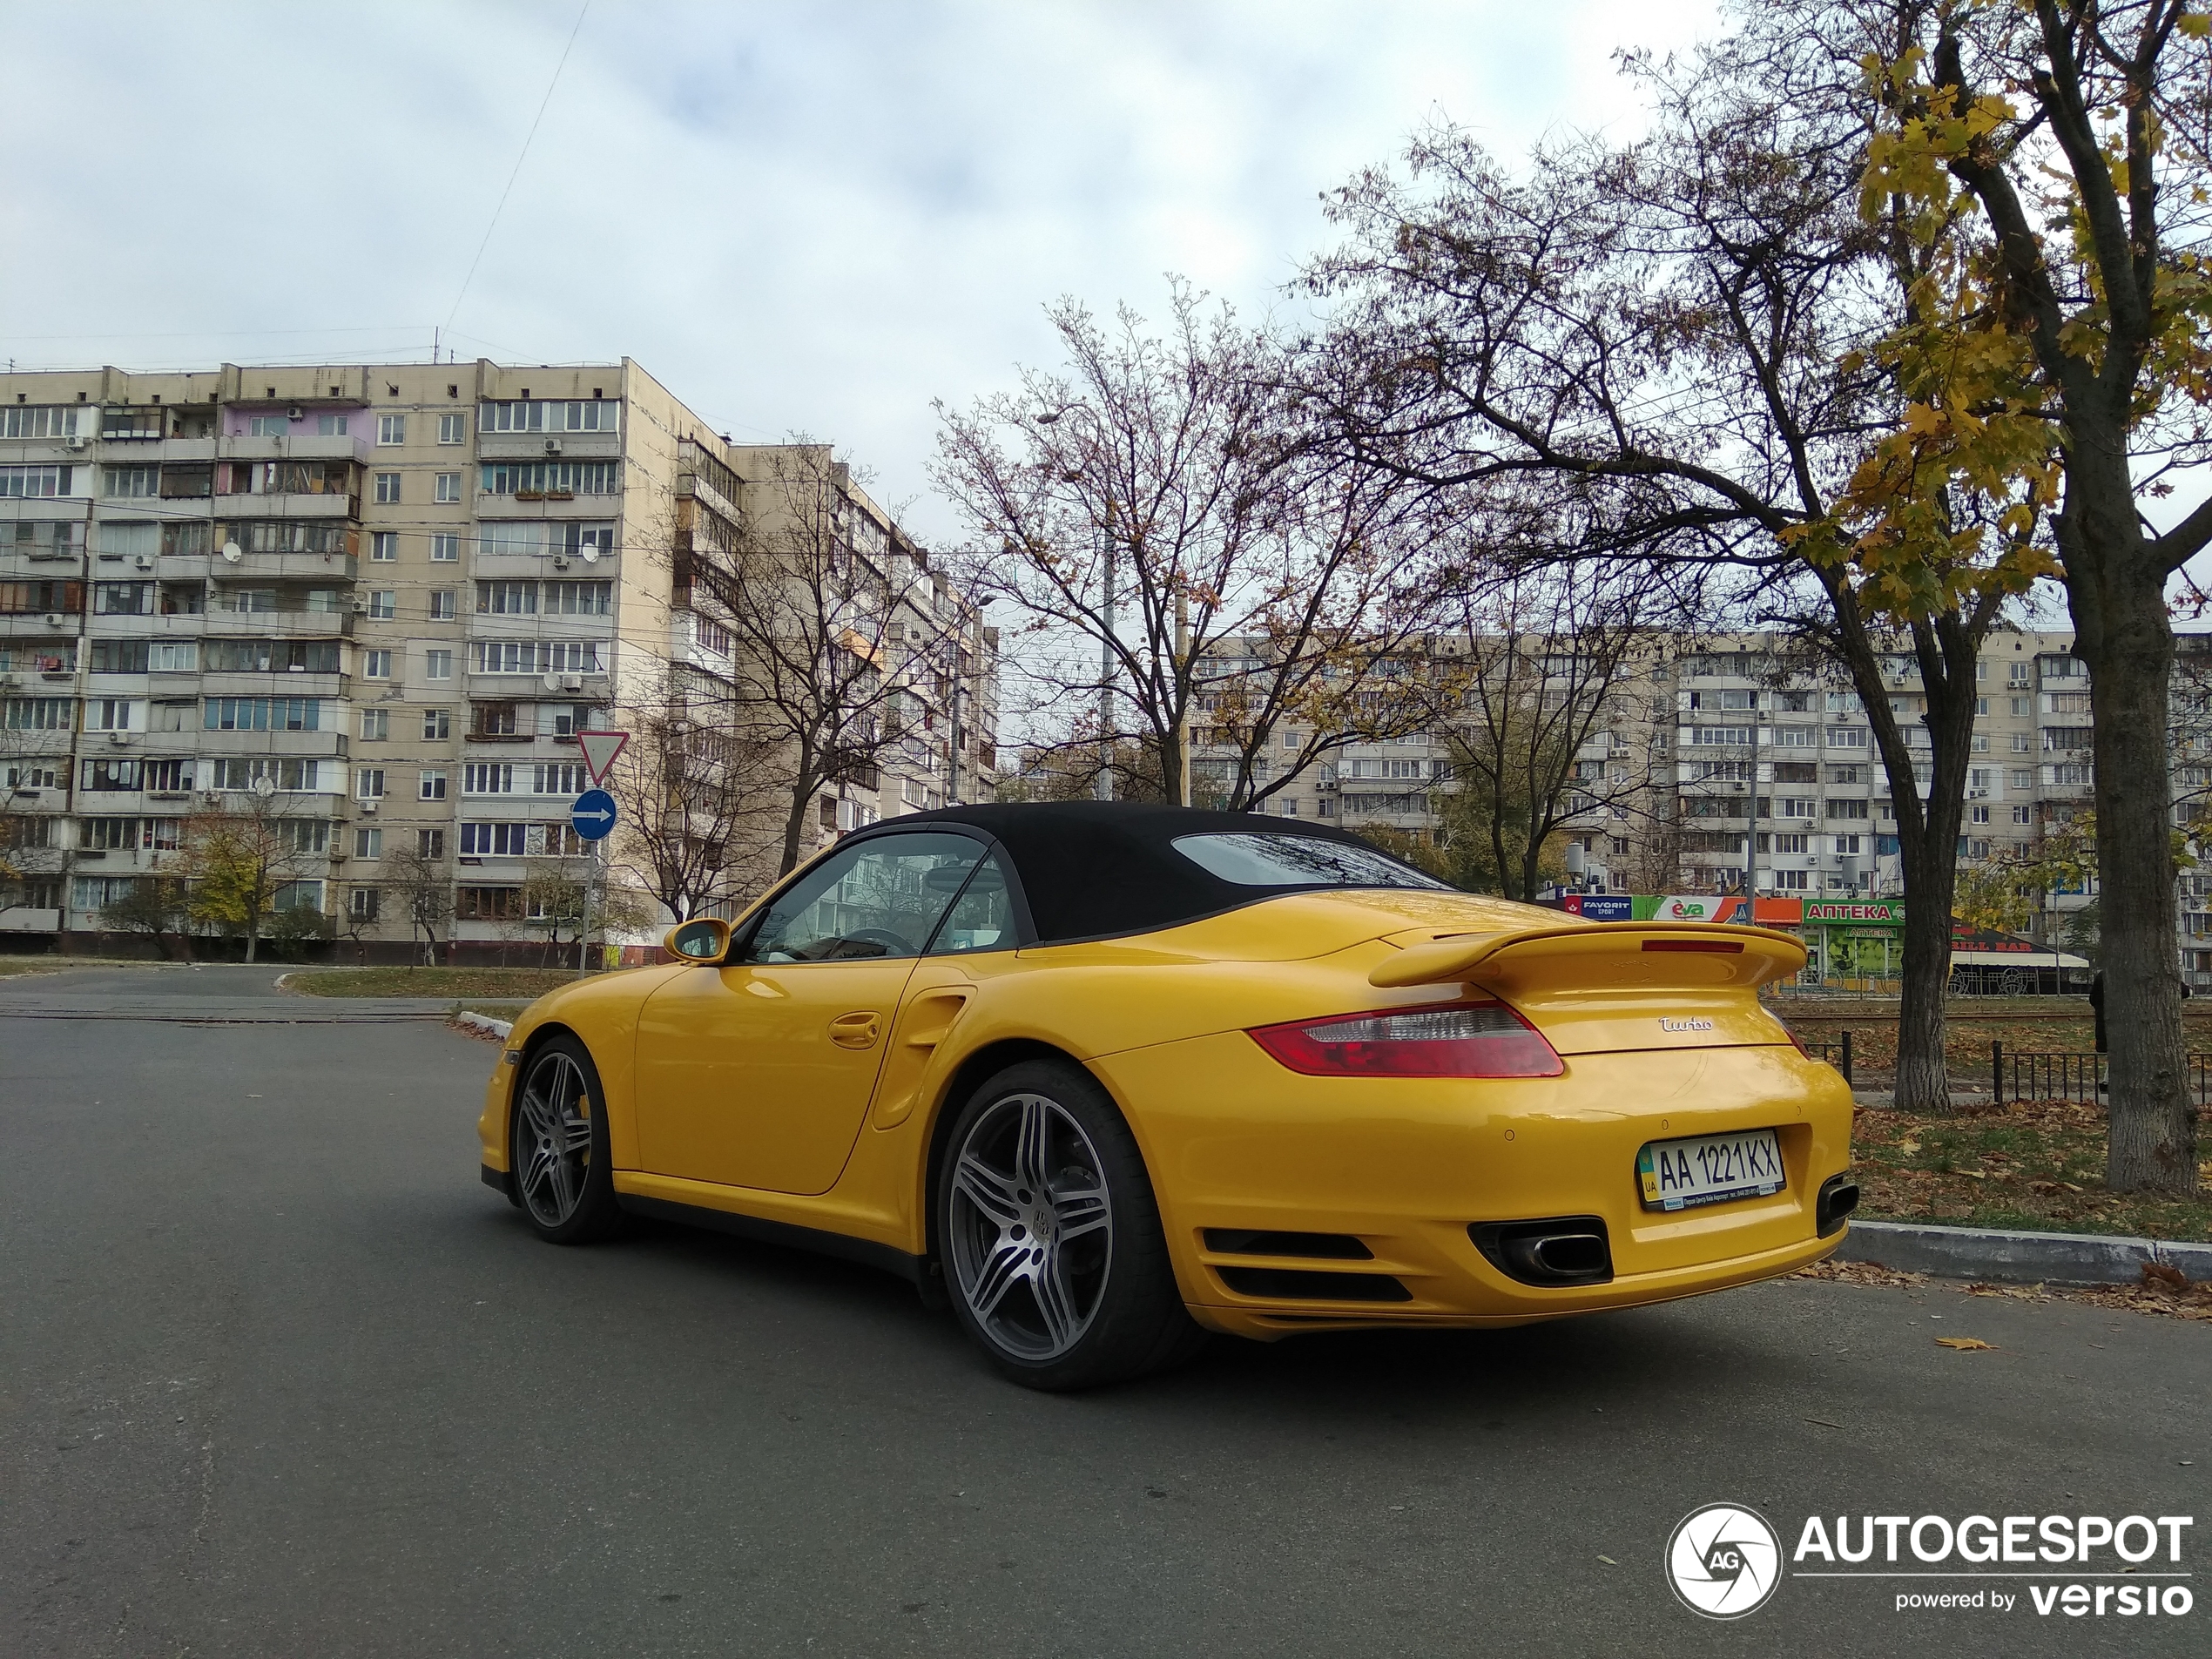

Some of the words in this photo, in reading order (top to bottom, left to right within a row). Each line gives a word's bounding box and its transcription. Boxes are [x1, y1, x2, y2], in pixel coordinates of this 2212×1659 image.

[1806, 904, 1892, 921] АПТЕКА
[1849, 928, 1894, 937] АПТЕКА
[1995, 941, 2033, 952] BAR
[1658, 1015, 1713, 1033] Turbo
[1660, 1148, 1695, 1191] AA
[1696, 1142, 1747, 1184] 1221
[1745, 1138, 1778, 1178] KX
[1645, 1180, 1657, 1193] UA
